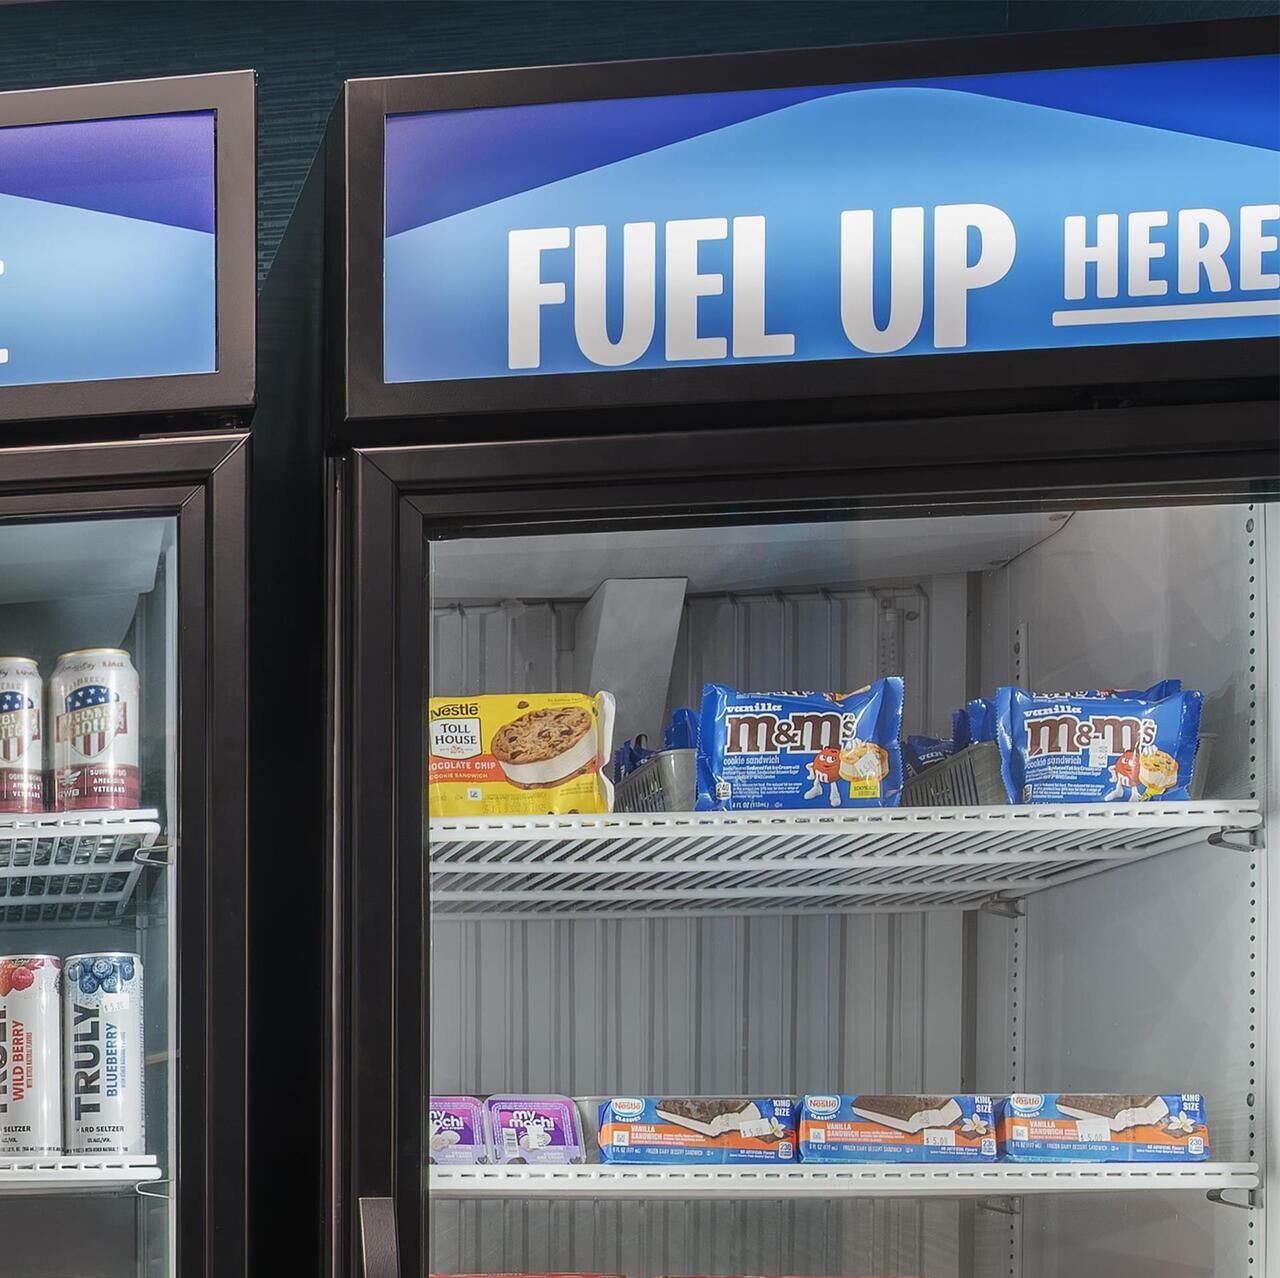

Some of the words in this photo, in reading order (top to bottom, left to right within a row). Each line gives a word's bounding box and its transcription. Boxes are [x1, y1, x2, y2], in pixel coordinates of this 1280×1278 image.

[507, 215, 796, 371] FUEL
[839, 203, 1017, 354] UP
[1063, 202, 1280, 302] HERE
[726, 704, 782, 714] vanilla
[441, 724, 470, 735] TOLL
[435, 735, 477, 745] HOUSE
[1047, 756, 1082, 766] sandwich
[12, 1020, 24, 1064] BERRY
[106, 1022, 118, 1097] BLUEBERRY
[12, 1066, 24, 1101] WILD
[775, 1108, 791, 1117] SIZE
[509, 1117, 553, 1129] mochi
[631, 1125, 655, 1133] VANILLA
